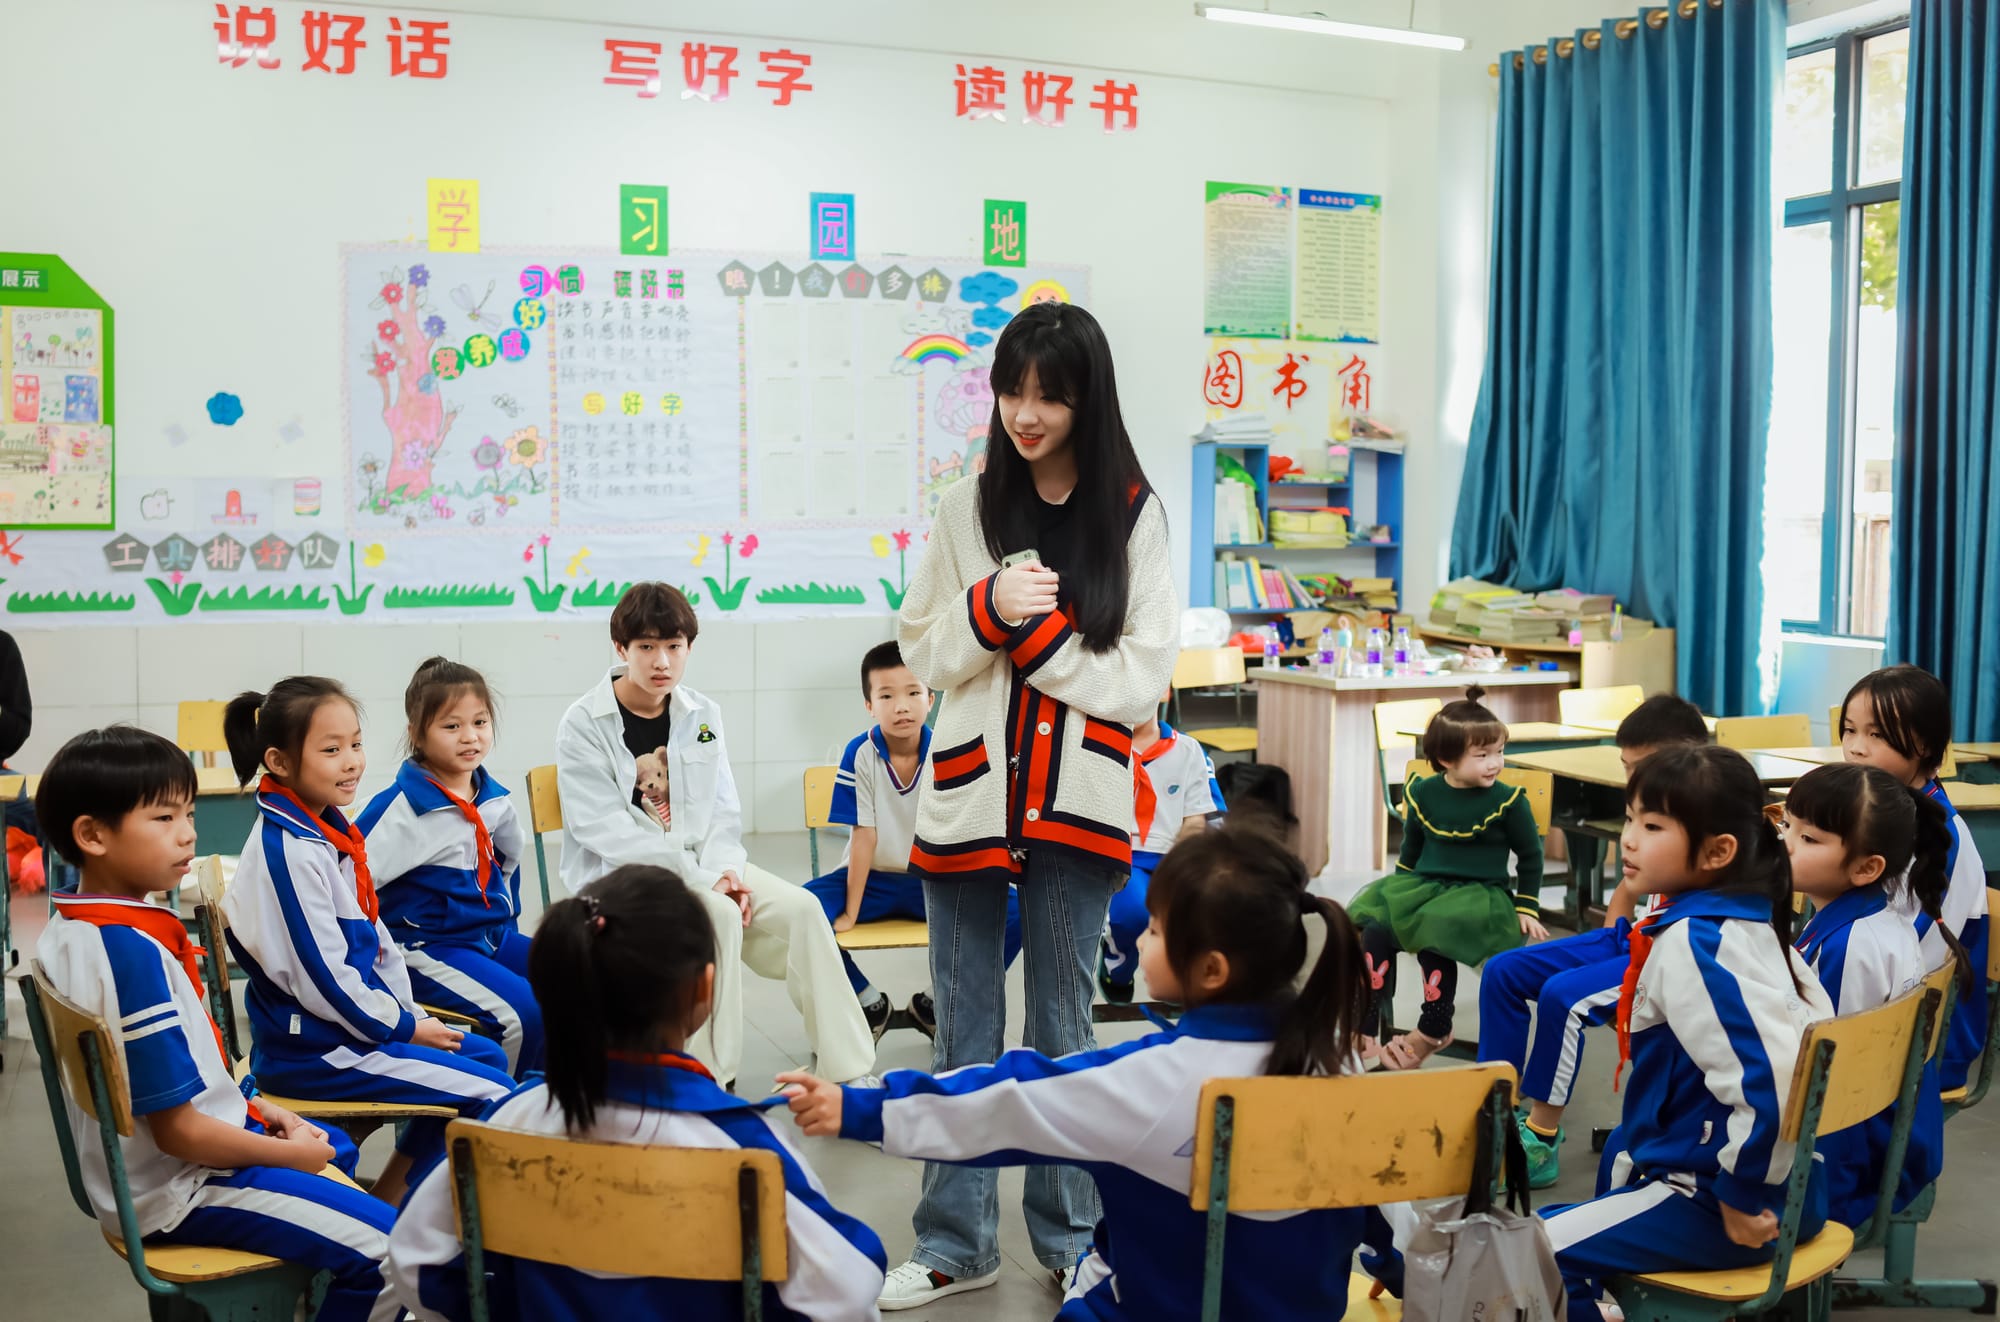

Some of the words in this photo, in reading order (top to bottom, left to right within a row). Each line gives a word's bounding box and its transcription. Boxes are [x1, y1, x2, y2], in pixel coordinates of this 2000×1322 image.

[214, 4, 450, 79] 说好话
[603, 39, 812, 106] 写好字
[955, 63, 1138, 133] 读好书
[2, 269, 40, 288] 展示
[615, 269, 686, 299] 读好书
[1203, 350, 1371, 411] 图书角
[583, 391, 682, 416] 写好字
[111, 539, 332, 570] 工具排好队
